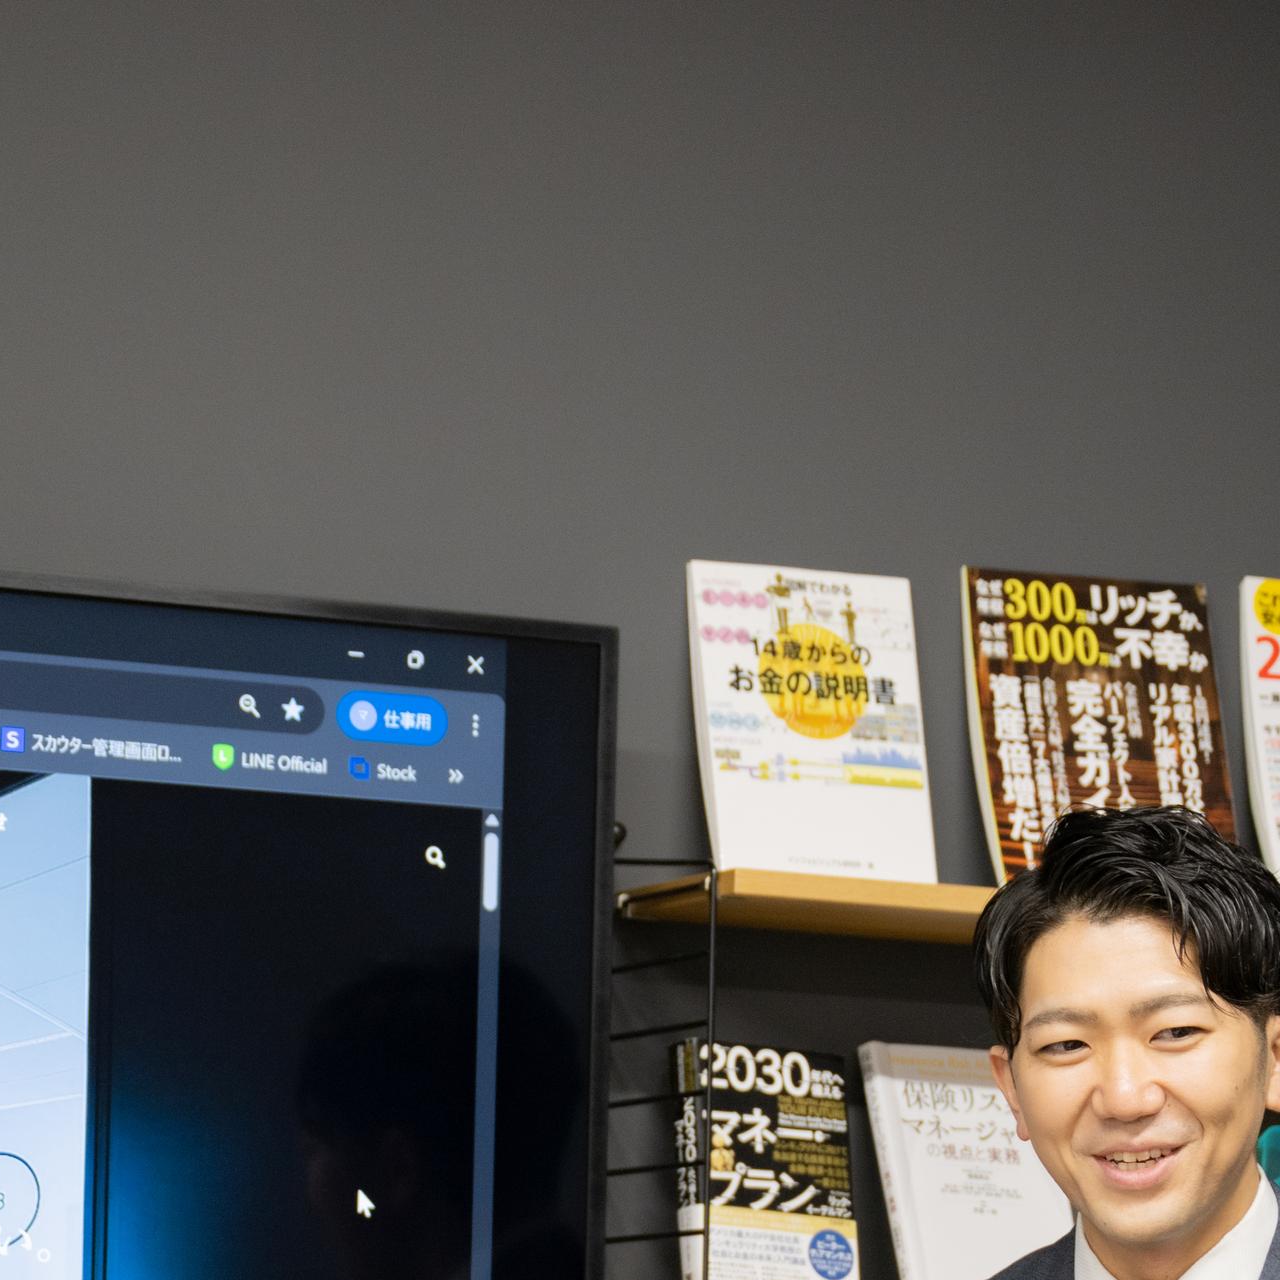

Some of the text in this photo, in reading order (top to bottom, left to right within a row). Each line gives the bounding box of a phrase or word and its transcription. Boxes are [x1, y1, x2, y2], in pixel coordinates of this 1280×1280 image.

[752, 638, 871, 666] 14歳からの
[729, 663, 897, 706] お金の説明書
[383, 709, 432, 731] 仕事用
[241, 751, 328, 775] LINE Official
[376, 763, 417, 783] Stock
[699, 1042, 812, 1098] 2030
[903, 1080, 1010, 1113] 保険リス
[709, 1162, 822, 1213] プラン
